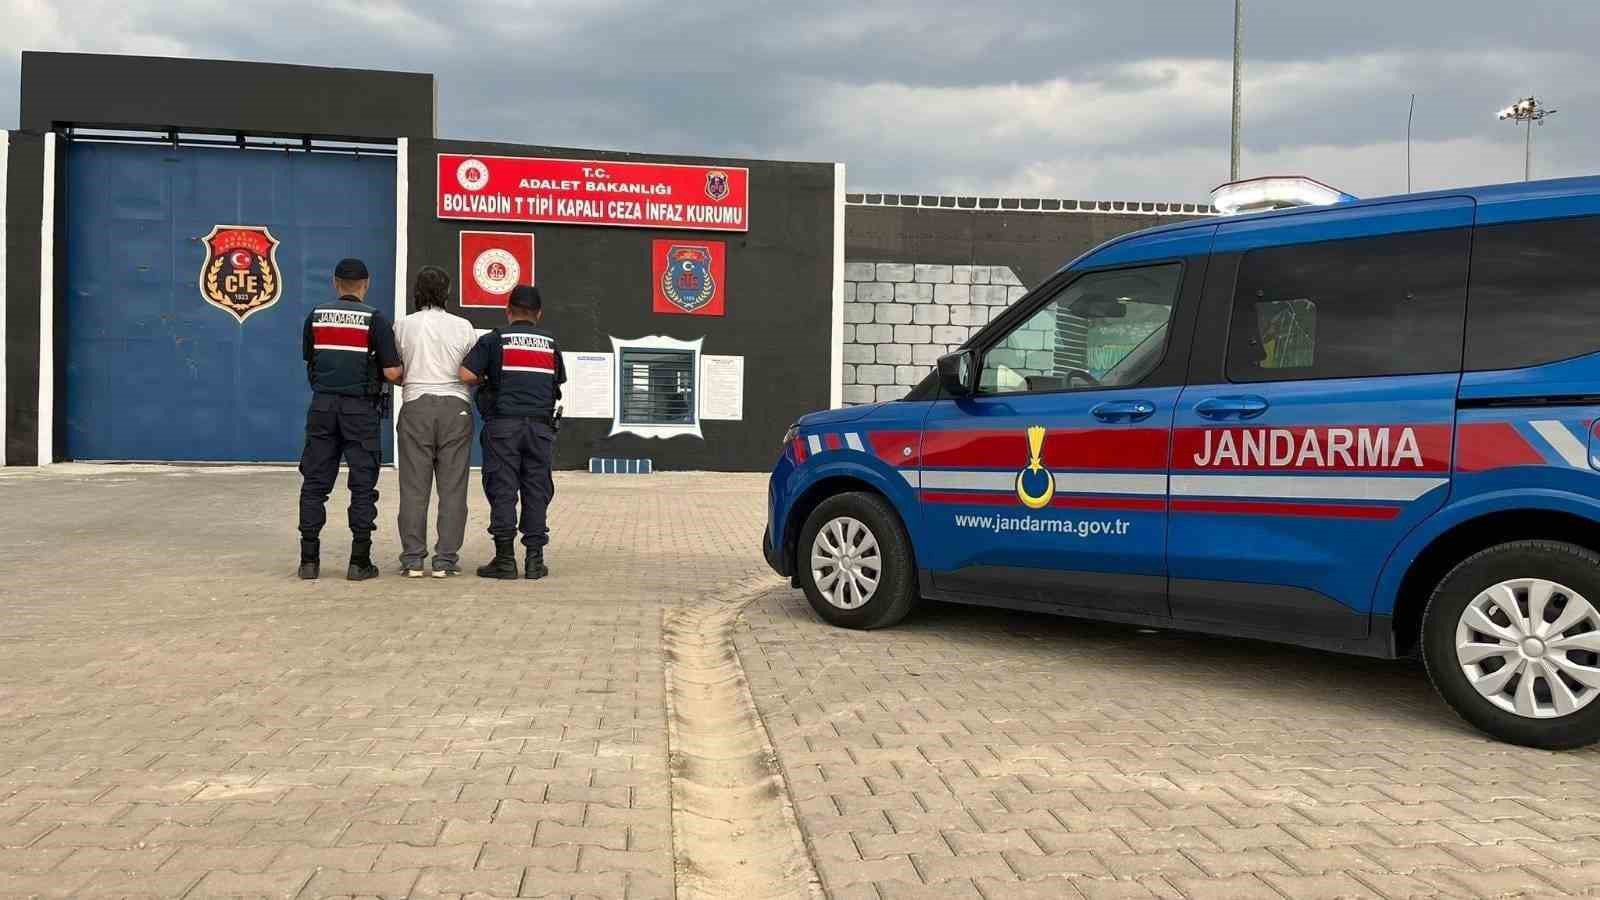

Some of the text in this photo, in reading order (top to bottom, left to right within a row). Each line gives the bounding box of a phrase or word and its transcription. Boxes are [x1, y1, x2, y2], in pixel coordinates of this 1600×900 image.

[582, 168, 610, 178] T.C.
[519, 179, 672, 195] ADALET BAKANLIĞI
[443, 192, 742, 224] BOLVADİN T TİPİ KAPALI CEZA İNFAZ KURUMU
[225, 269, 258, 293] CTE
[319, 311, 365, 325] JANDARMA
[508, 335, 551, 349] JANDARMA
[1194, 427, 1424, 467] JANDARMA
[955, 513, 1130, 537] www.jandarma.gov.tr
